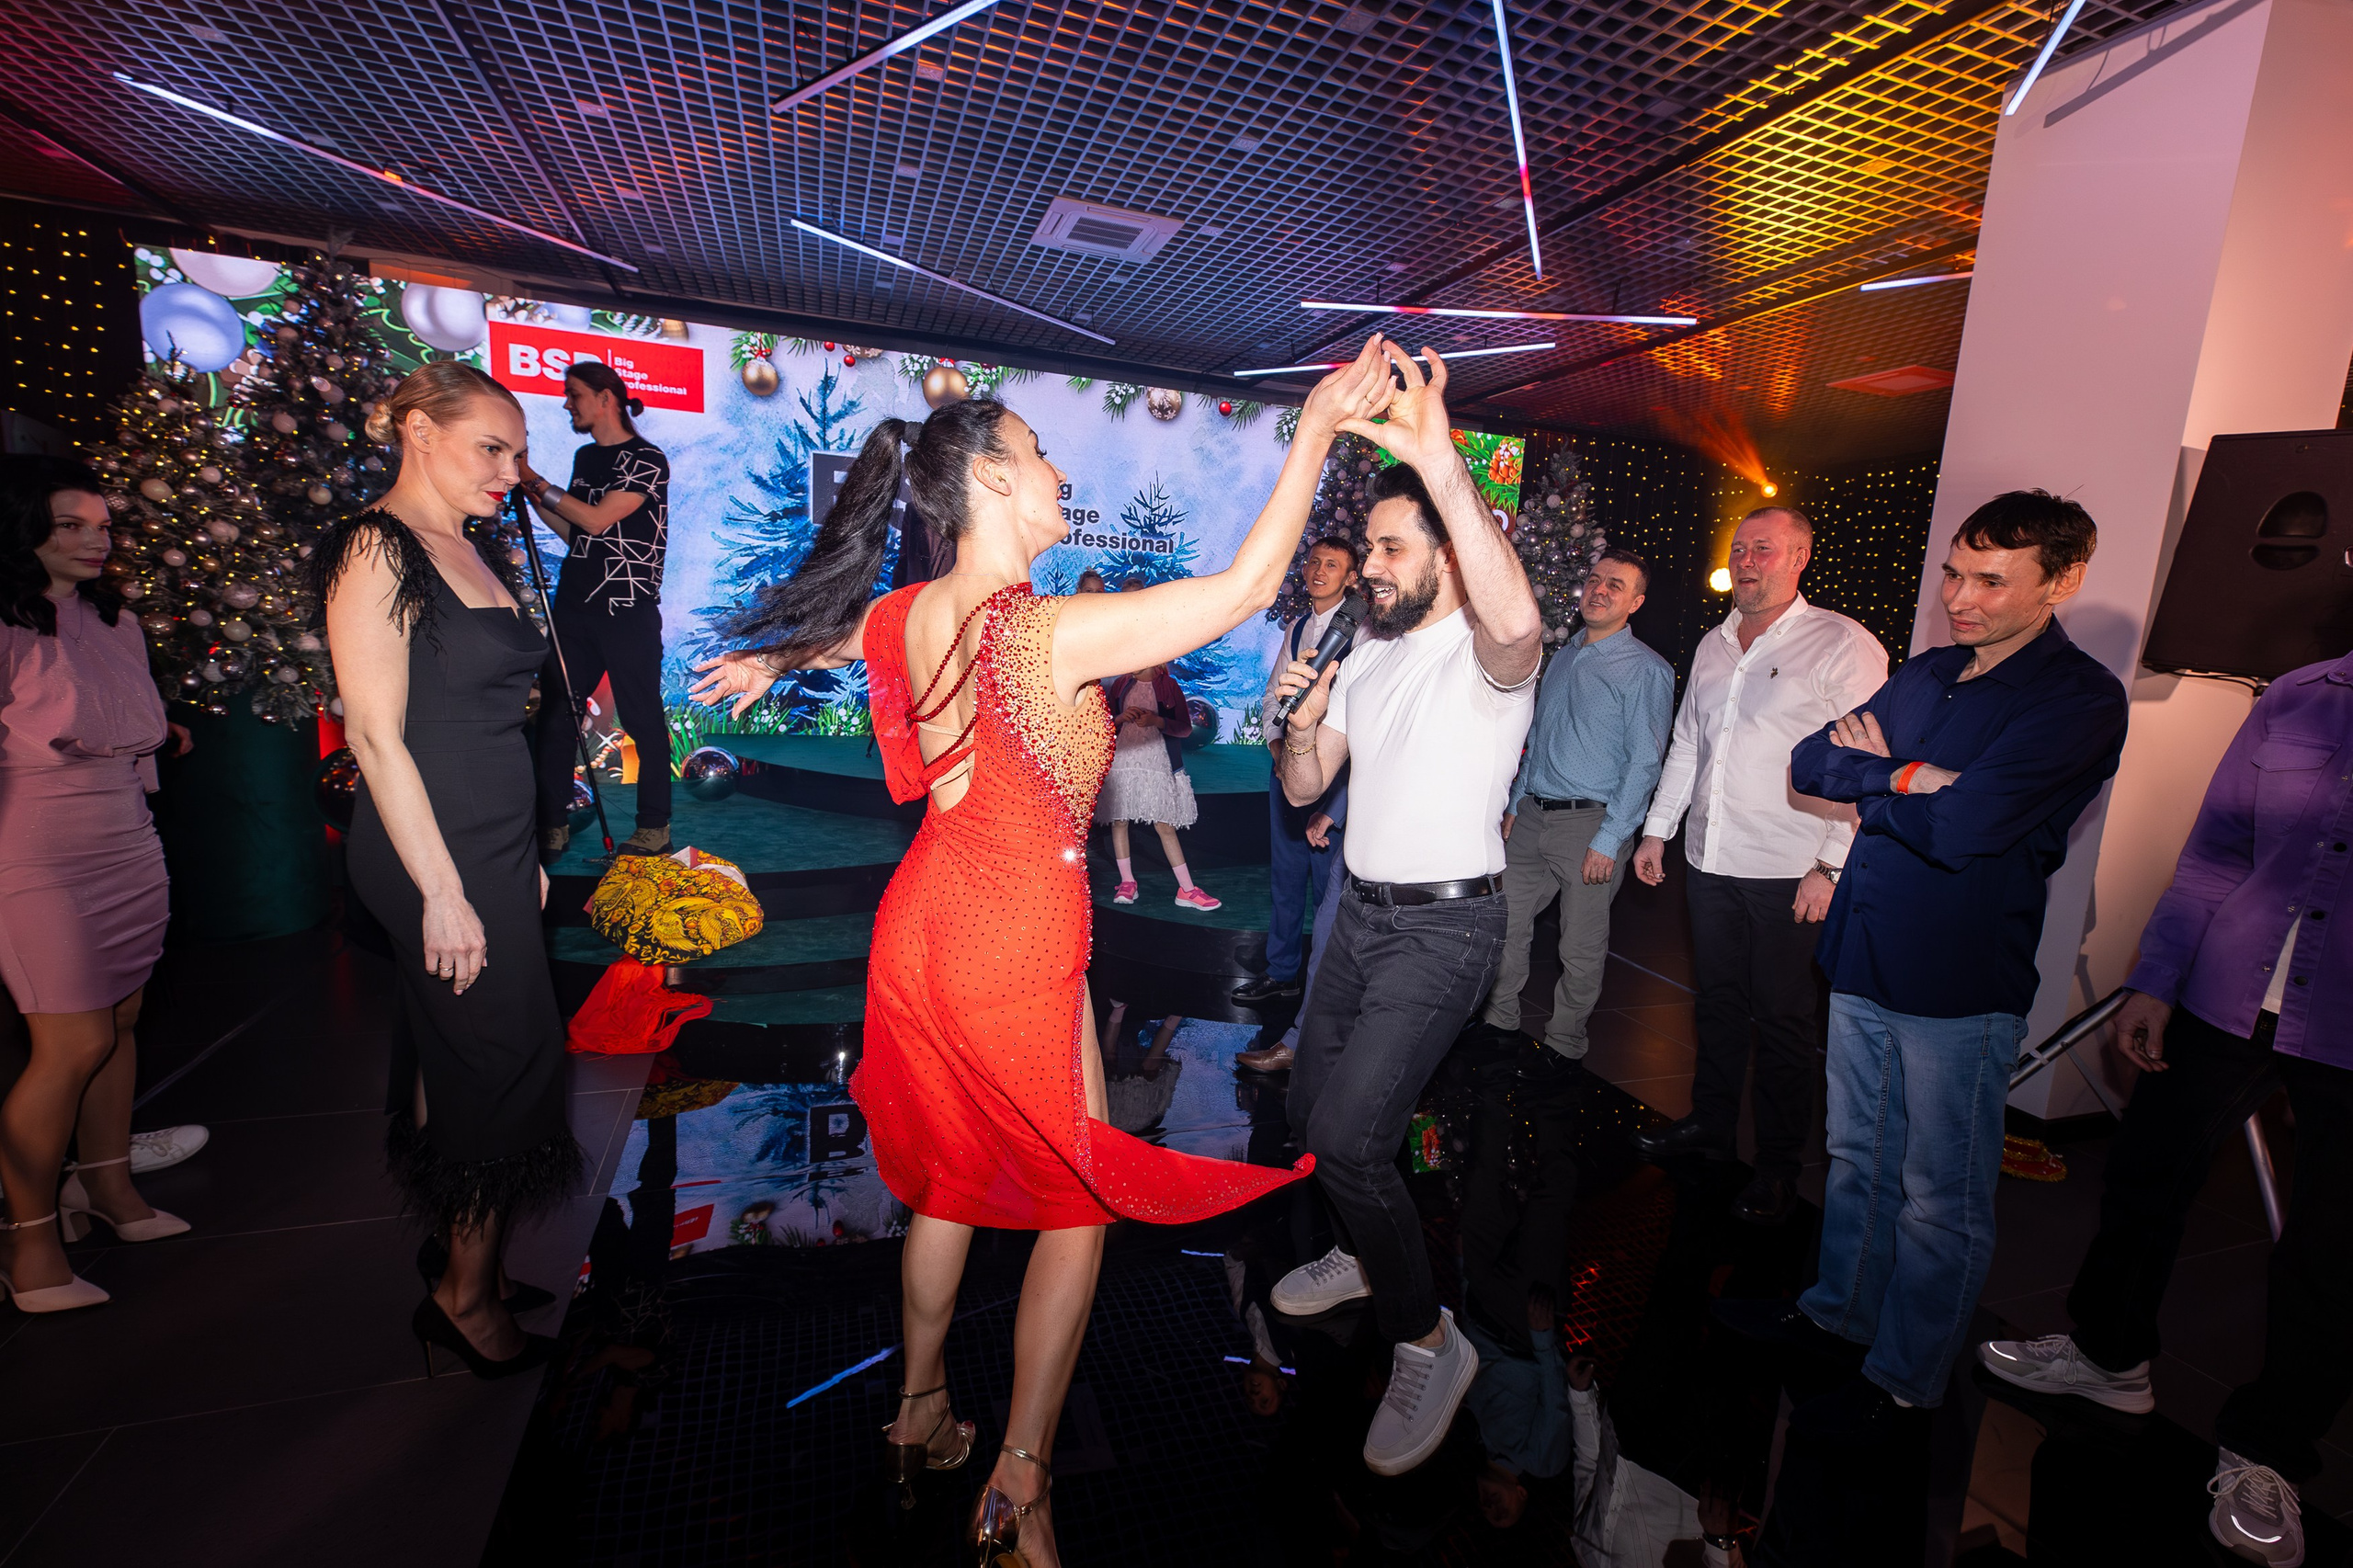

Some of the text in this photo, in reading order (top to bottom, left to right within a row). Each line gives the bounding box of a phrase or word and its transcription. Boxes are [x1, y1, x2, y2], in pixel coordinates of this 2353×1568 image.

[614, 357, 634, 369] Big
[614, 368, 649, 381] Stage
[1062, 507, 1100, 526] age
[1061, 528, 1175, 553] ofessional
